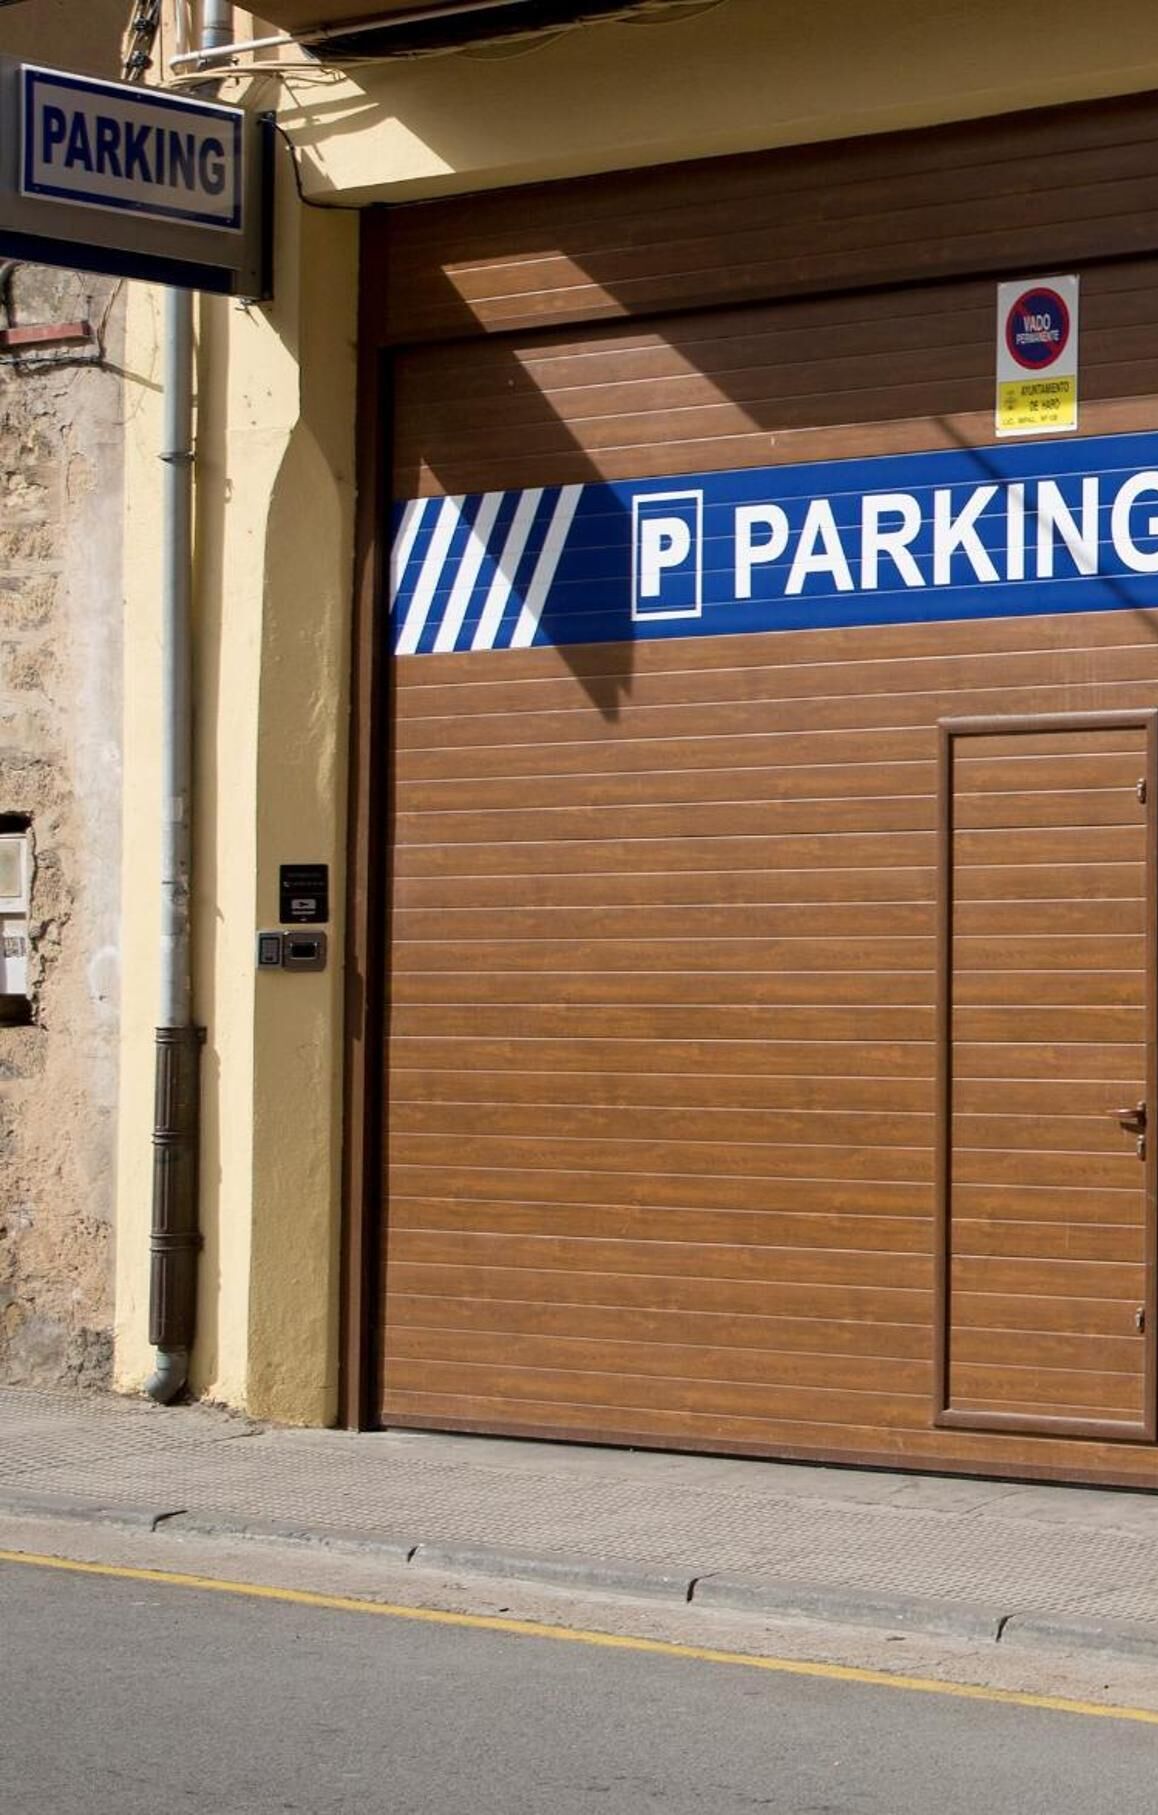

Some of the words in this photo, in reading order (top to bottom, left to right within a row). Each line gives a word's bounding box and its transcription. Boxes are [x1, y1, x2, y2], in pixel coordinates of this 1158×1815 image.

[42, 104, 226, 196] PARKING
[1023, 313, 1051, 332] VADO
[1020, 380, 1070, 396] AYUNTAMIENTO
[640, 515, 691, 598] P
